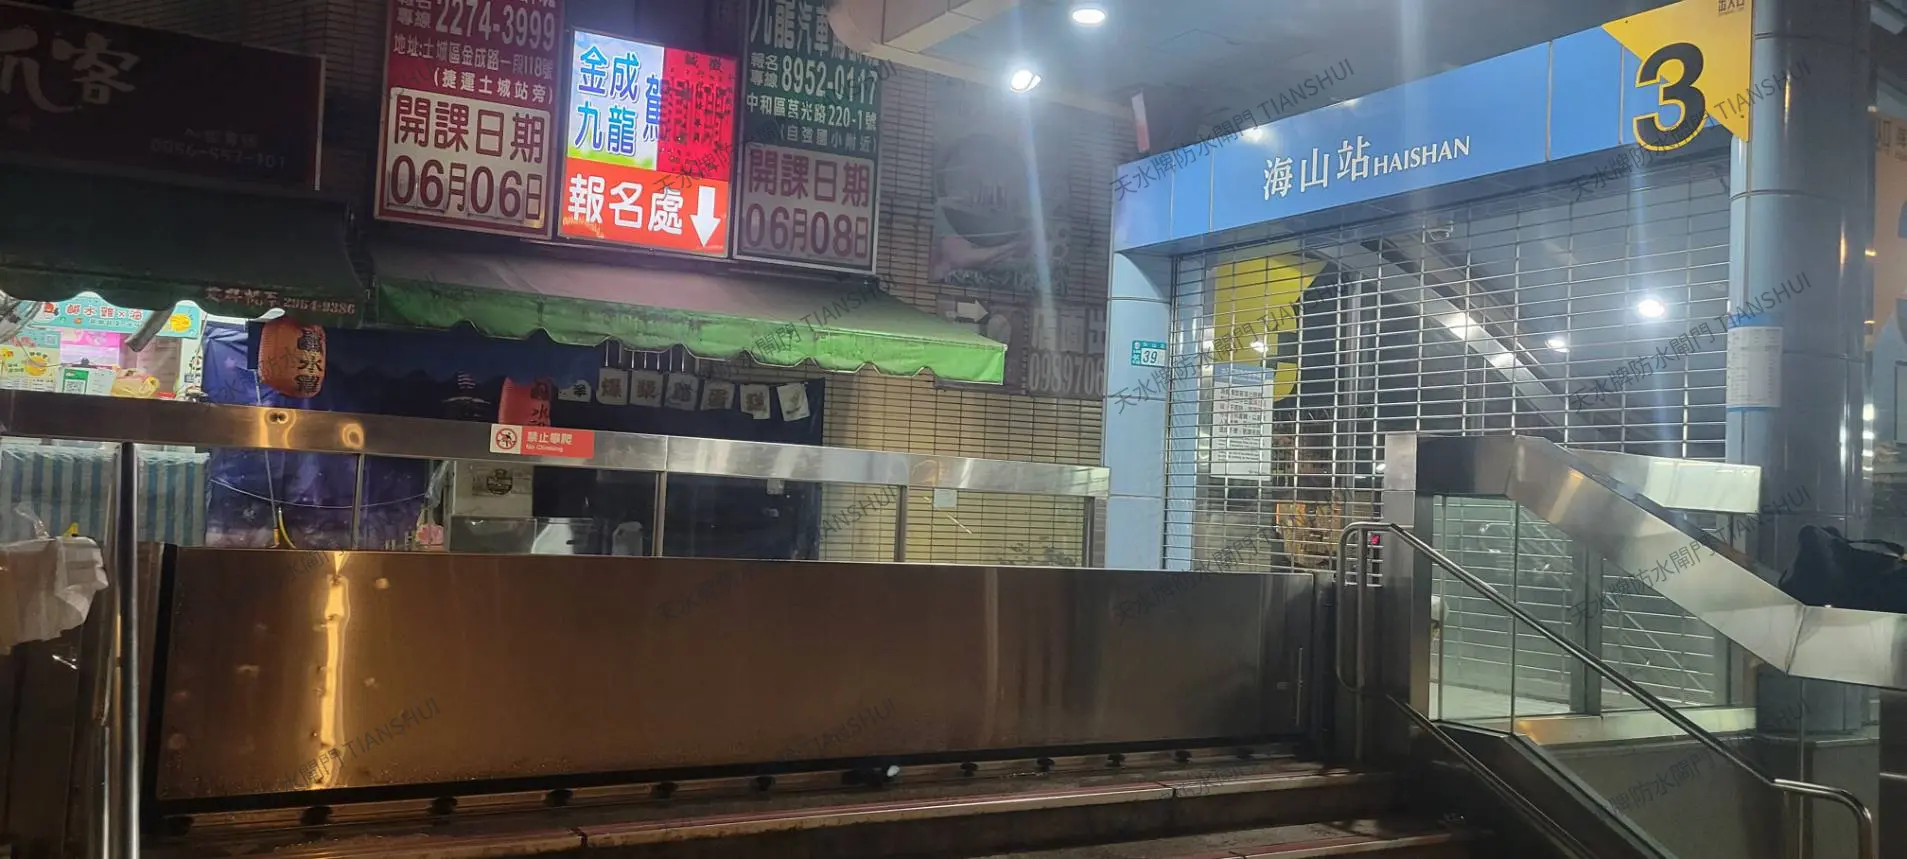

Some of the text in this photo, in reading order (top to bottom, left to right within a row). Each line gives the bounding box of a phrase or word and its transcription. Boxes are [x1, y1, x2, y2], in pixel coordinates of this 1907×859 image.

[396, 9, 432, 29] 專線
[435, 0, 556, 52] 2274-3999
[750, 0, 879, 66] 九龍汽車
[578, 45, 640, 101] 金成
[751, 52, 778, 71] 報名
[781, 55, 878, 105] 8952-0117
[1633, 42, 1708, 151] 3
[394, 94, 545, 165] 開課日期
[574, 101, 637, 156] 九龍
[390, 155, 541, 221] 06月06日
[748, 148, 870, 209] 開課日期
[1264, 136, 1471, 200] 海山站 HAISHAN
[568, 173, 684, 236] 報名處
[744, 203, 869, 259] 06月08日
[1143, 350, 1158, 364] 39
